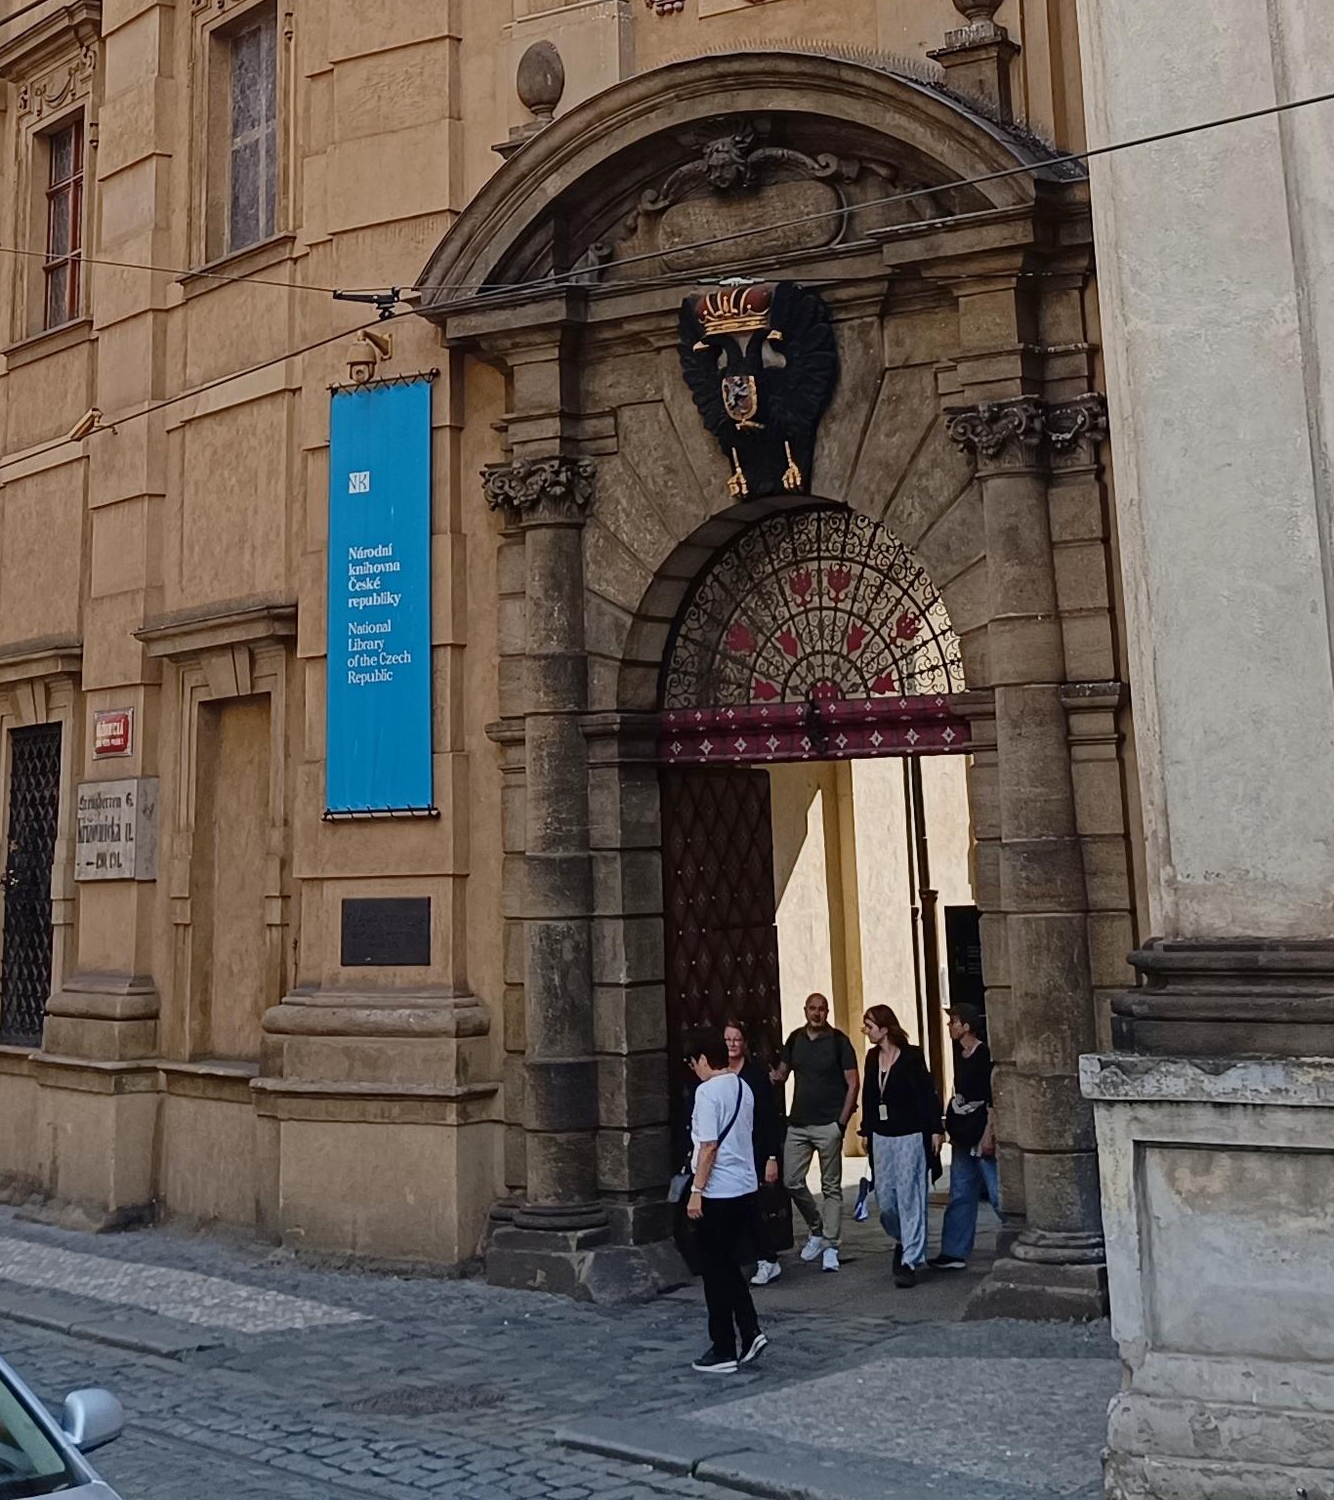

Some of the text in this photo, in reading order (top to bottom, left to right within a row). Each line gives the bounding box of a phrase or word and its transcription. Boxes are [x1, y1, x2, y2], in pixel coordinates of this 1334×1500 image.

[348, 543, 392, 560] Národní
[348, 561, 400, 576] knihovna
[348, 576, 381, 592] České
[348, 592, 401, 610] republiky
[348, 619, 392, 635] National
[348, 638, 385, 652] Library
[347, 650, 411, 668] of the Czech
[347, 668, 393, 686] Republic
